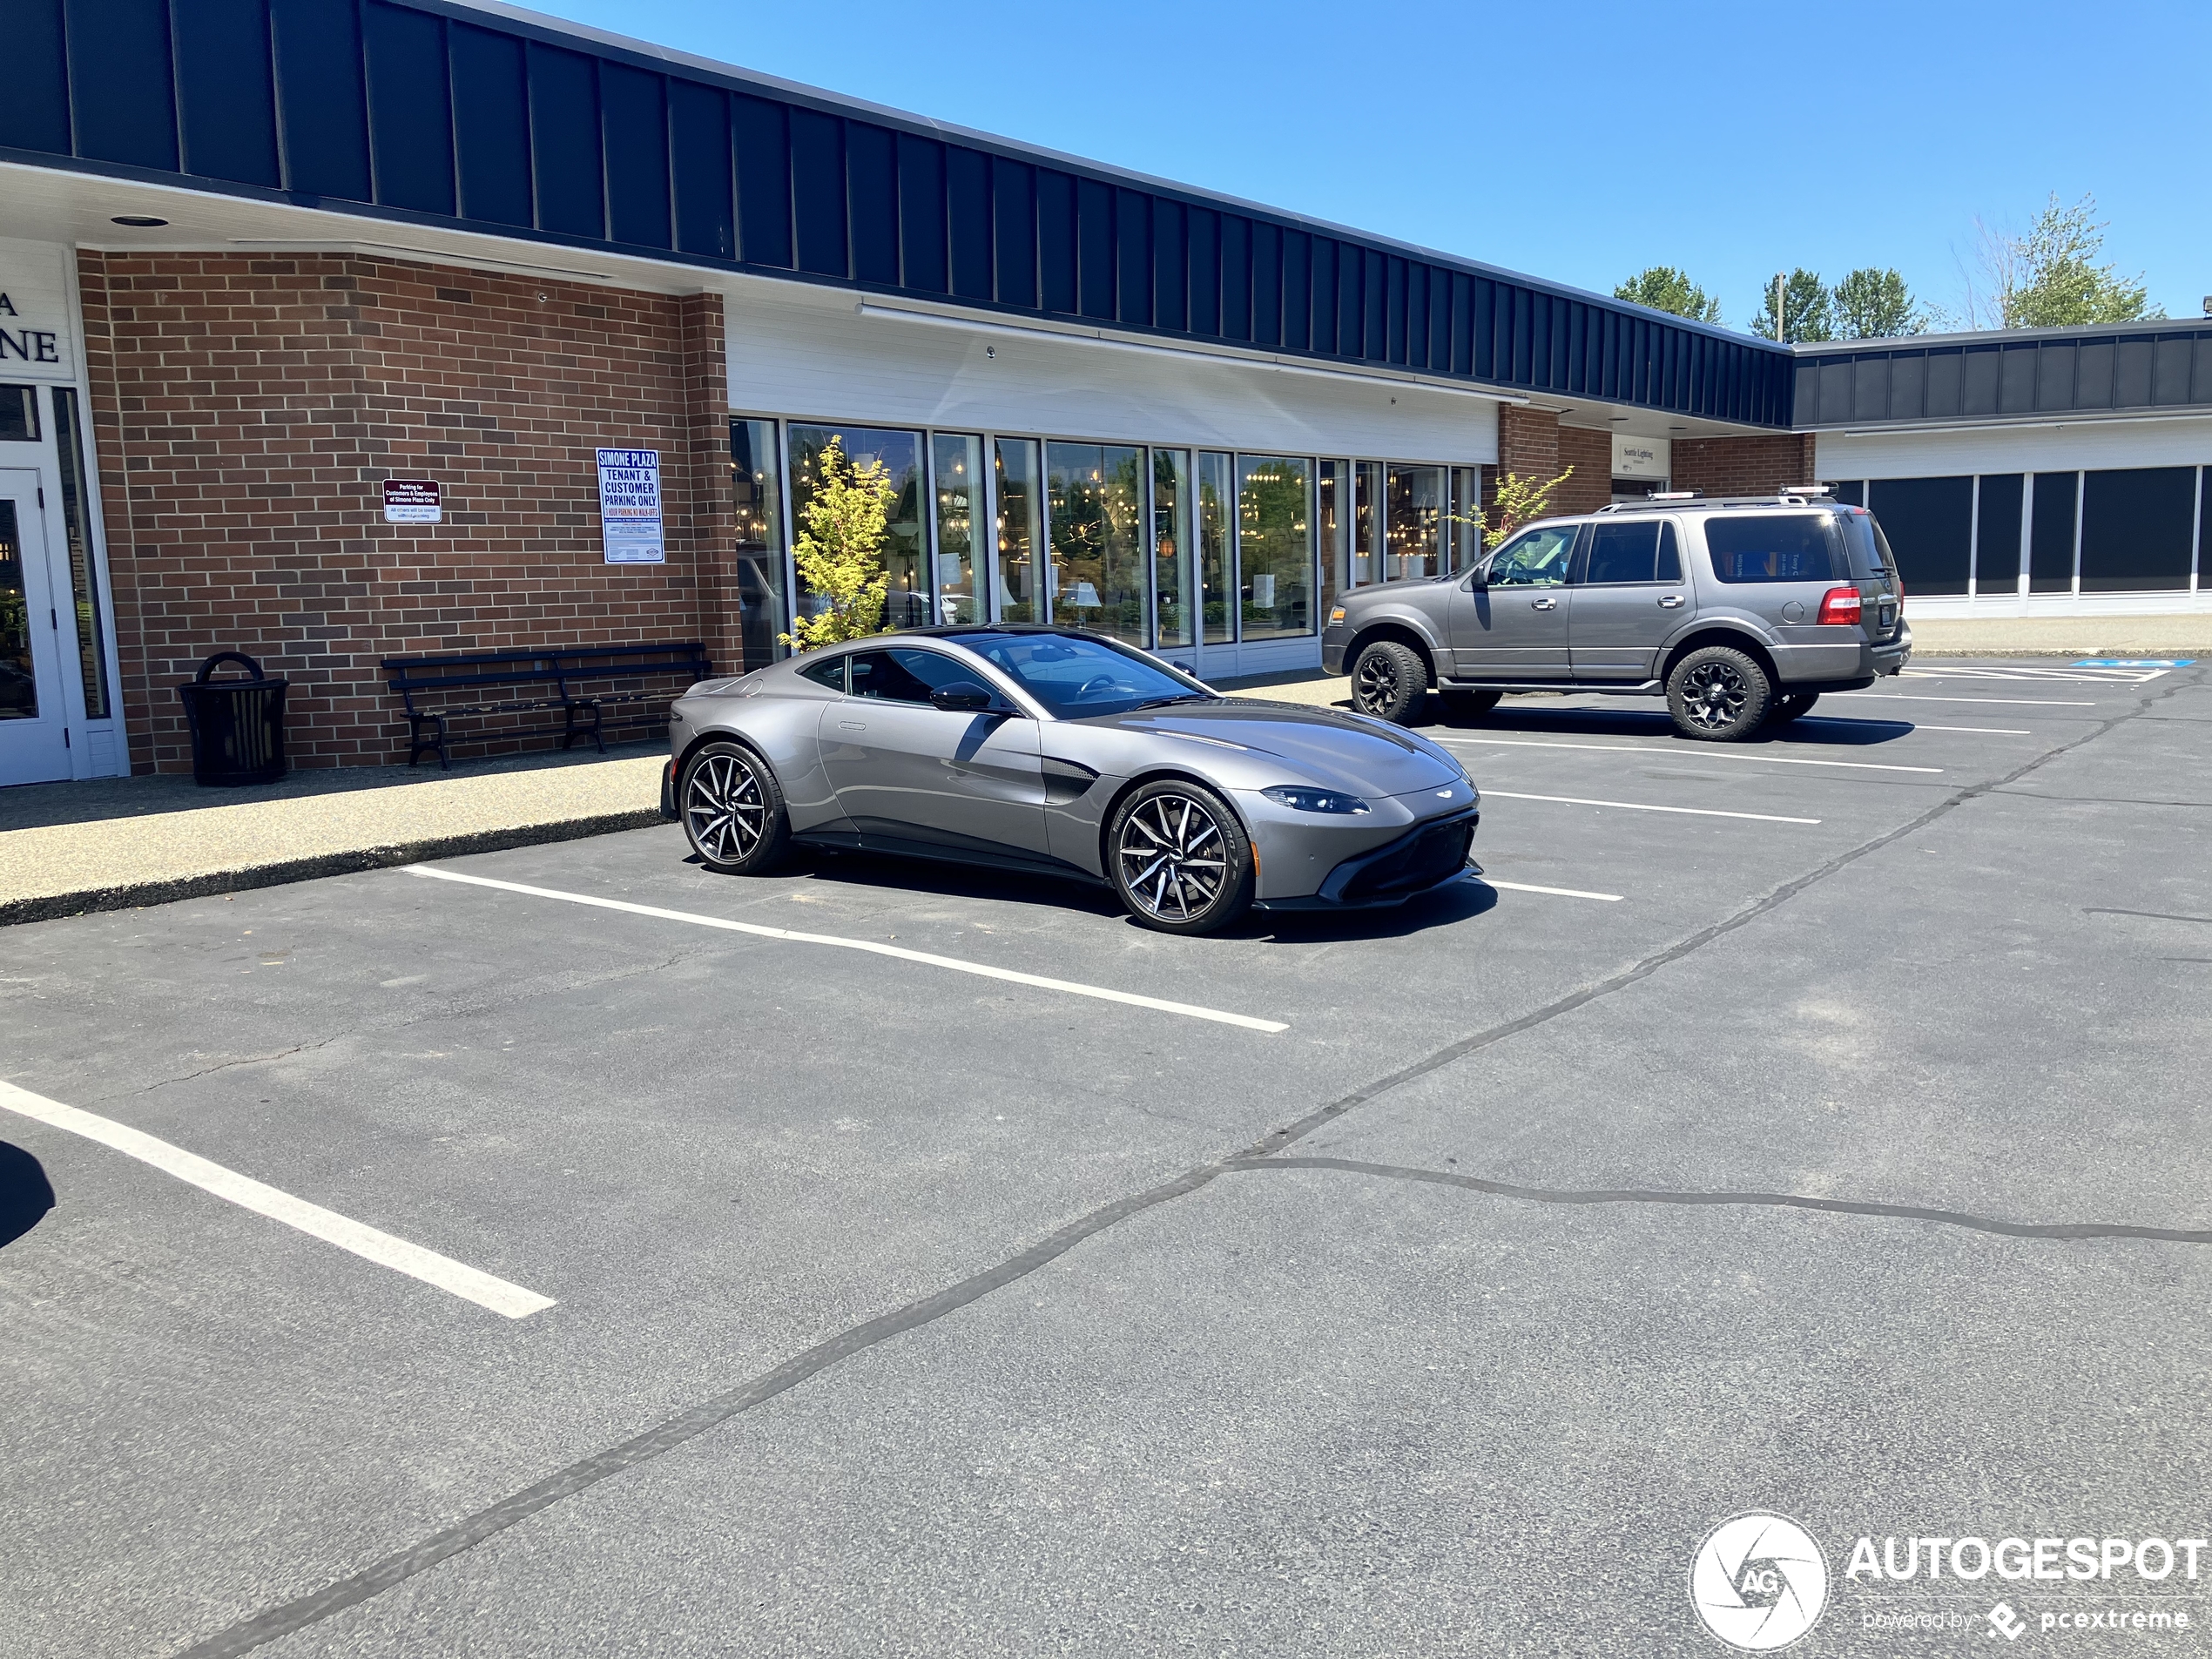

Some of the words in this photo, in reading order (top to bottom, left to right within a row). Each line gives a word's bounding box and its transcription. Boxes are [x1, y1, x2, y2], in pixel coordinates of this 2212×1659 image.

[599, 451, 630, 466] SIMONE
[631, 453, 656, 467] PLAZA
[1624, 448, 1636, 456] Seattle
[1637, 448, 1653, 460] Lighting
[606, 469, 640, 481] TENANT
[644, 470, 651, 481] &
[605, 482, 654, 494] CUSTOMER
[605, 496, 636, 506] PARKING
[638, 496, 656, 506] ONLY
[1113, 807, 1127, 833] PIRELLI
